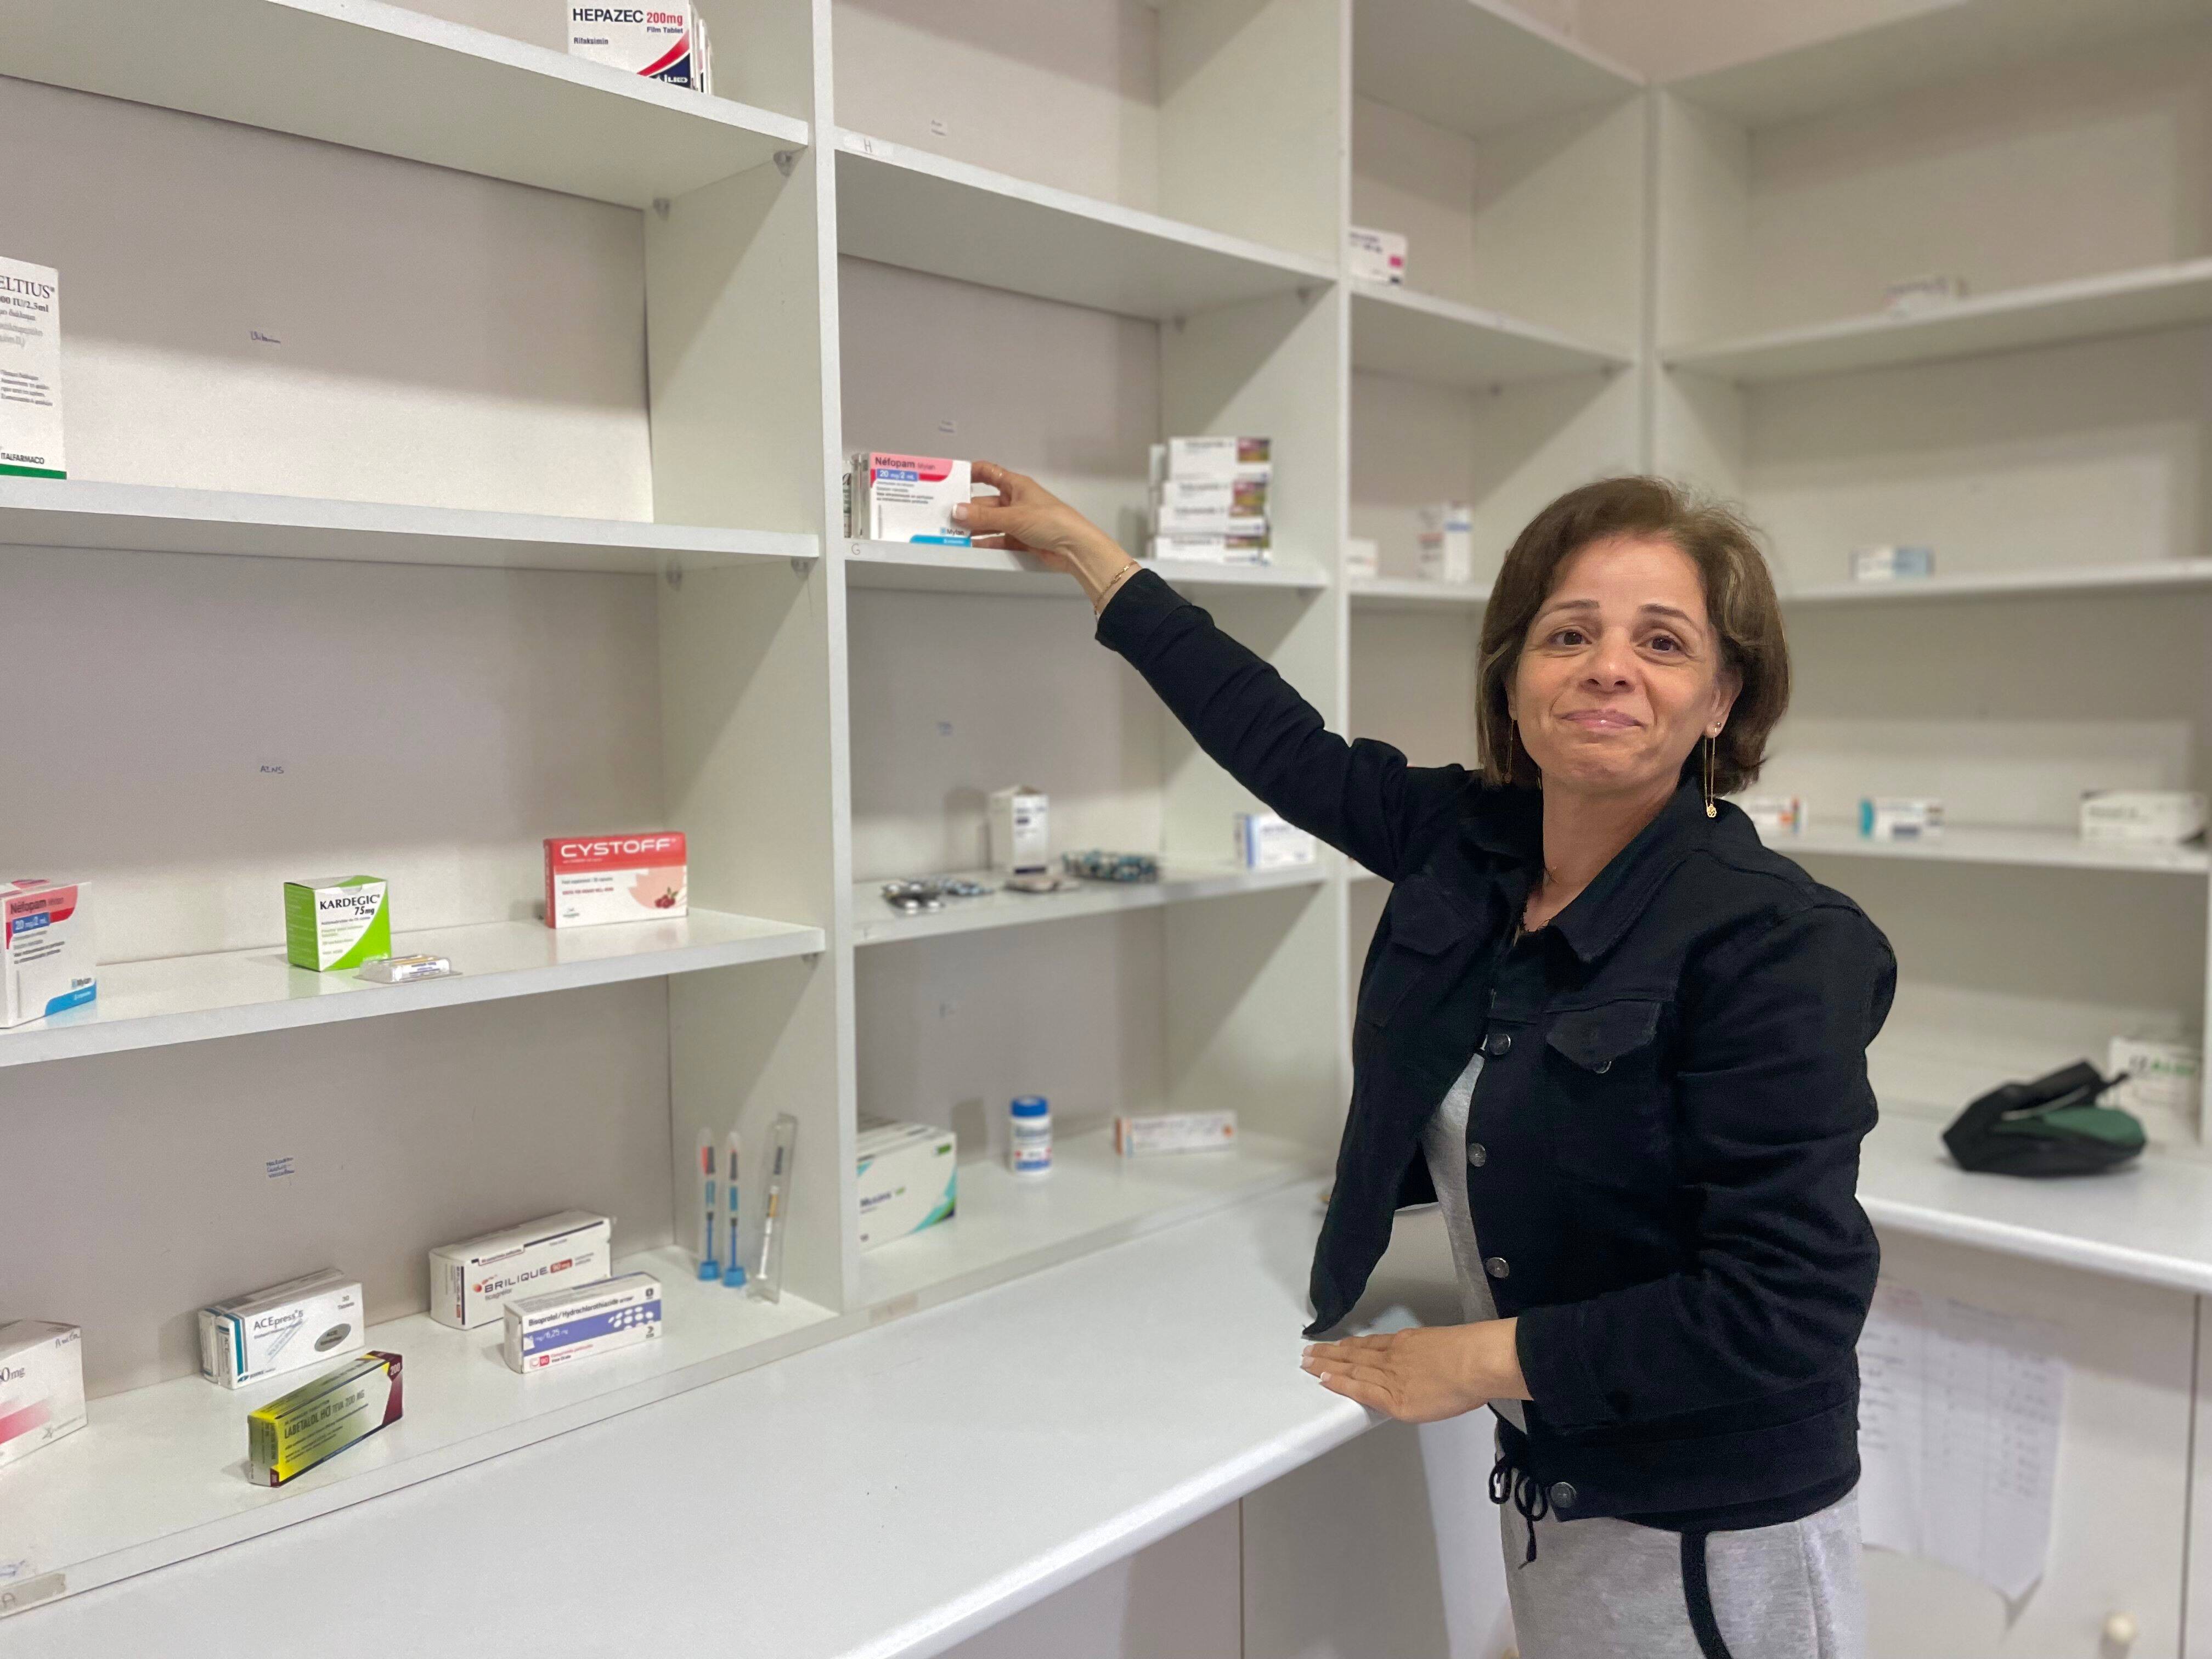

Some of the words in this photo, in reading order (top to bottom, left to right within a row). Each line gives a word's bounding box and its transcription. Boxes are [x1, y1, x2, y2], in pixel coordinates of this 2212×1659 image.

[573, 8, 644, 23] HEPAZEC
[646, 12, 683, 26] 200mg
[574, 37, 609, 45] Rifaksimin
[864, 138, 872, 153] H
[1, 453, 44, 465] ITALFARMACO
[875, 456, 916, 468] Néfopam
[851, 543, 860, 555] G
[561, 837, 670, 858] CYSTOFF
[484, 1266, 549, 1293] BRILIQUE
[284, 1415, 318, 1439] LABETALOL
